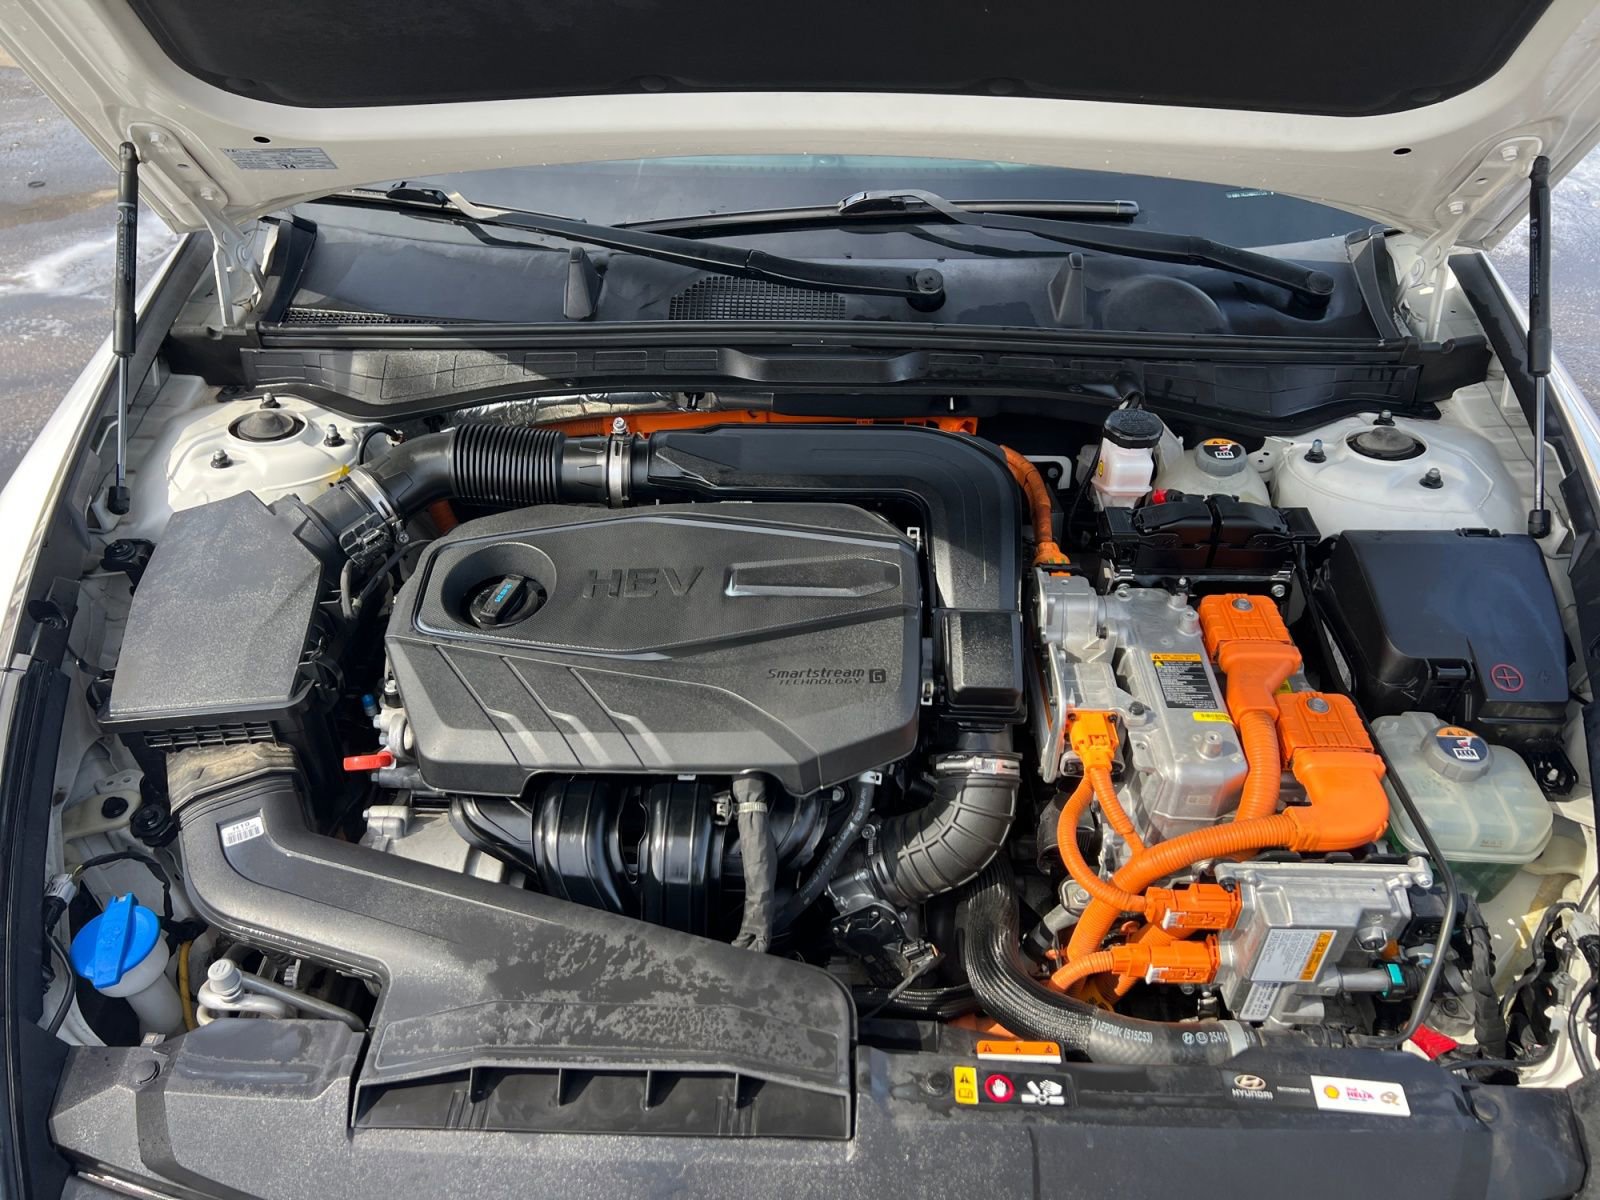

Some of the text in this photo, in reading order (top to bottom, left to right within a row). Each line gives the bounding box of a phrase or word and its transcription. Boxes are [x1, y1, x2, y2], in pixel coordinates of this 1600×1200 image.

[582, 567, 704, 598] HEV
[766, 667, 887, 684] Smartstream G
[778, 677, 862, 686] TECHNOLOGY
[1231, 1087, 1274, 1101] HYUNDAI
